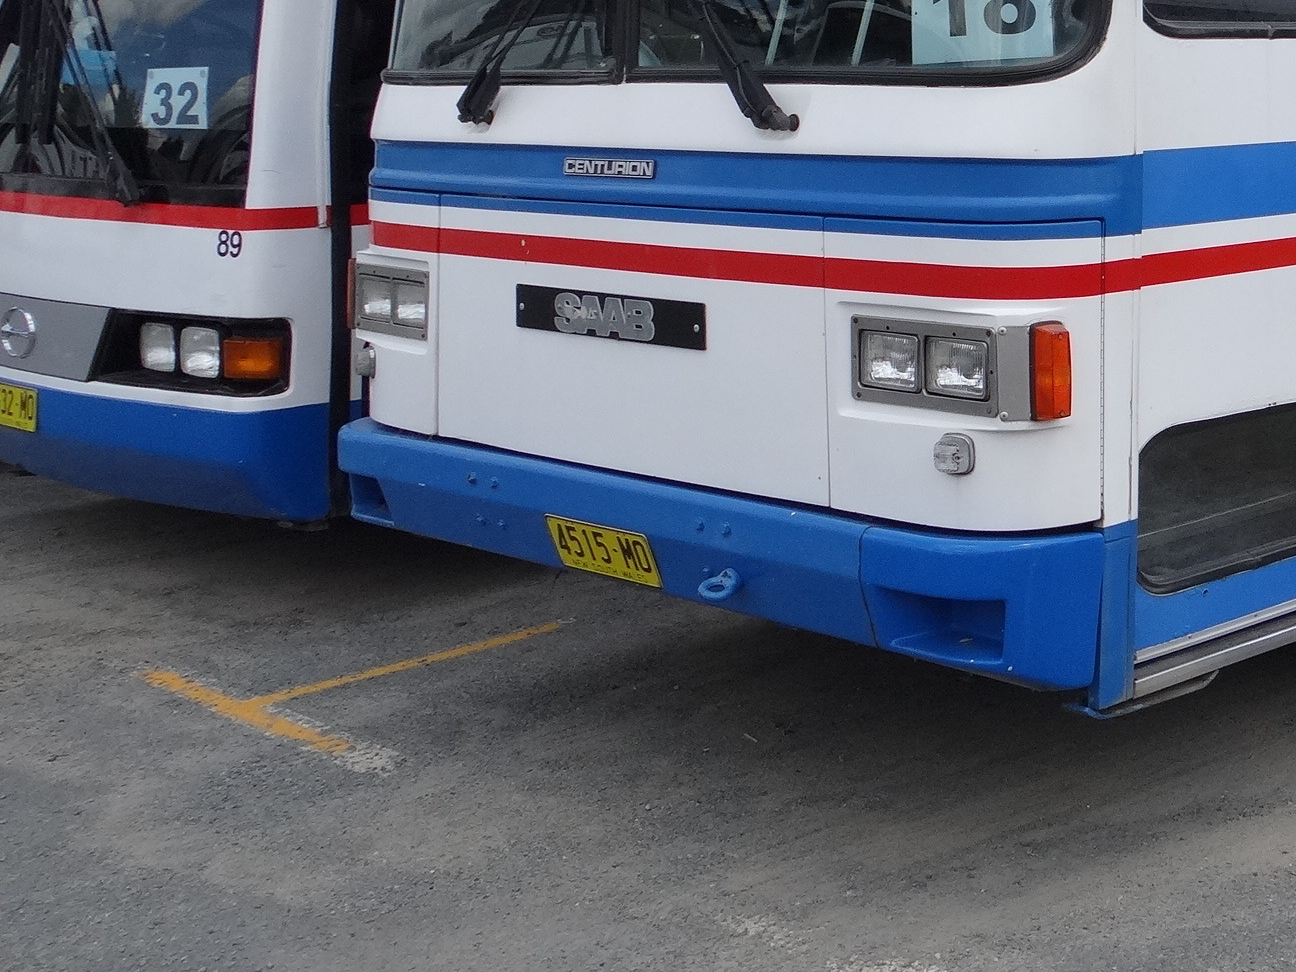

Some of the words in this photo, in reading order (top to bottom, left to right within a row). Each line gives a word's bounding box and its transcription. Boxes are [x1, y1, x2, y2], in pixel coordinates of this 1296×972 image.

[151, 81, 200, 127] 32
[565, 159, 653, 177] CENTURION
[216, 230, 243, 259] 89
[554, 292, 655, 342] SAAB
